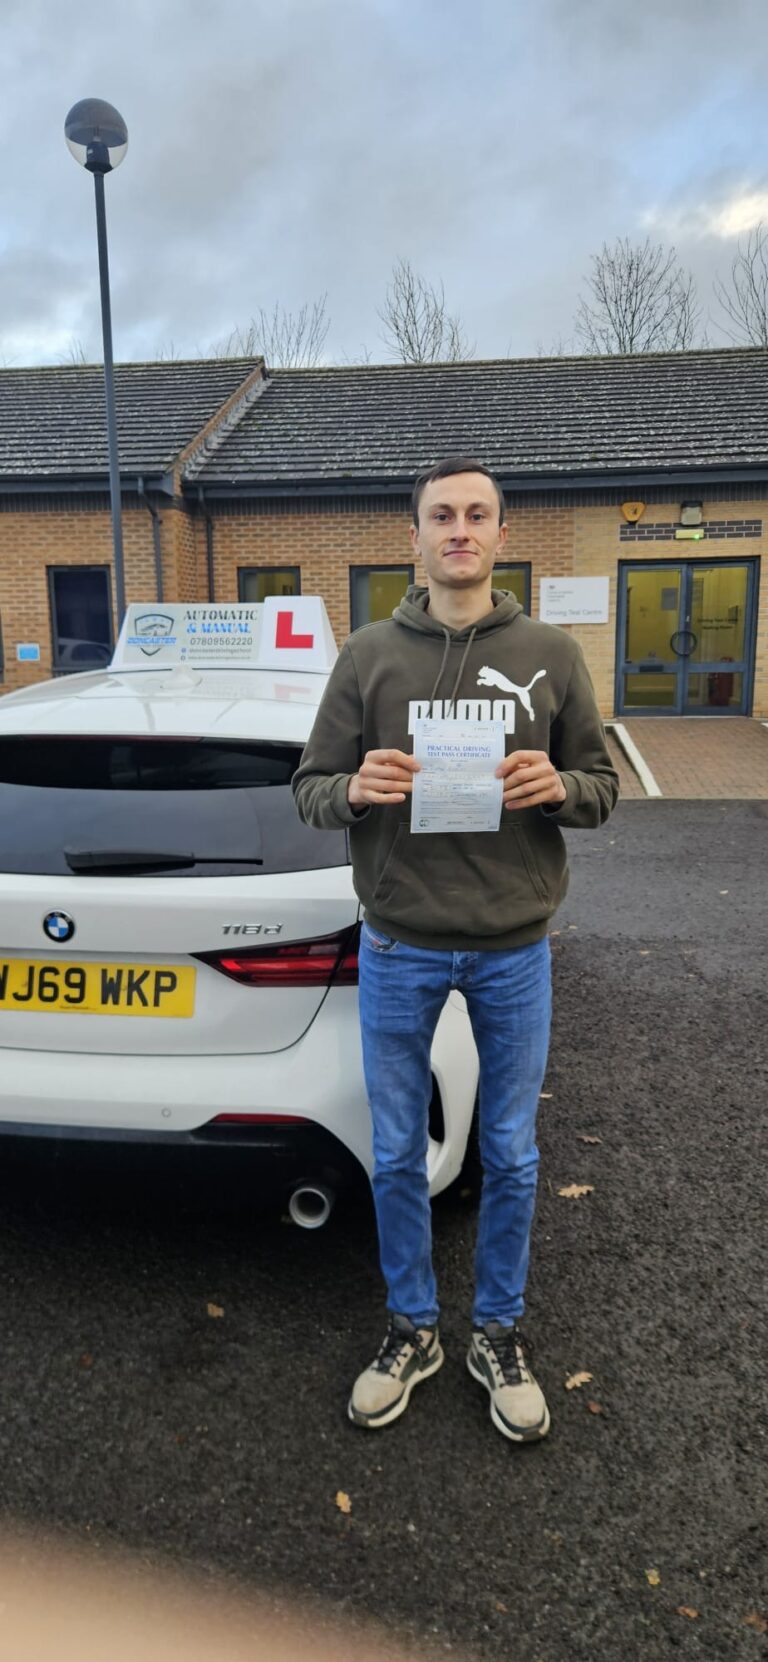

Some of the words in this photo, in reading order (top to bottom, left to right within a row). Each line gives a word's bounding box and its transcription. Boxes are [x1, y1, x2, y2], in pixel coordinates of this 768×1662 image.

[184, 610, 258, 620] AUTOMATIC
[186, 623, 197, 633] &
[201, 623, 251, 633] MANUAL
[275, 611, 314, 648] L
[127, 636, 177, 645] DONCASTER
[190, 637, 253, 646] 07809562220
[222, 923, 283, 935] 118d
[100, 968, 177, 1007] WKP
